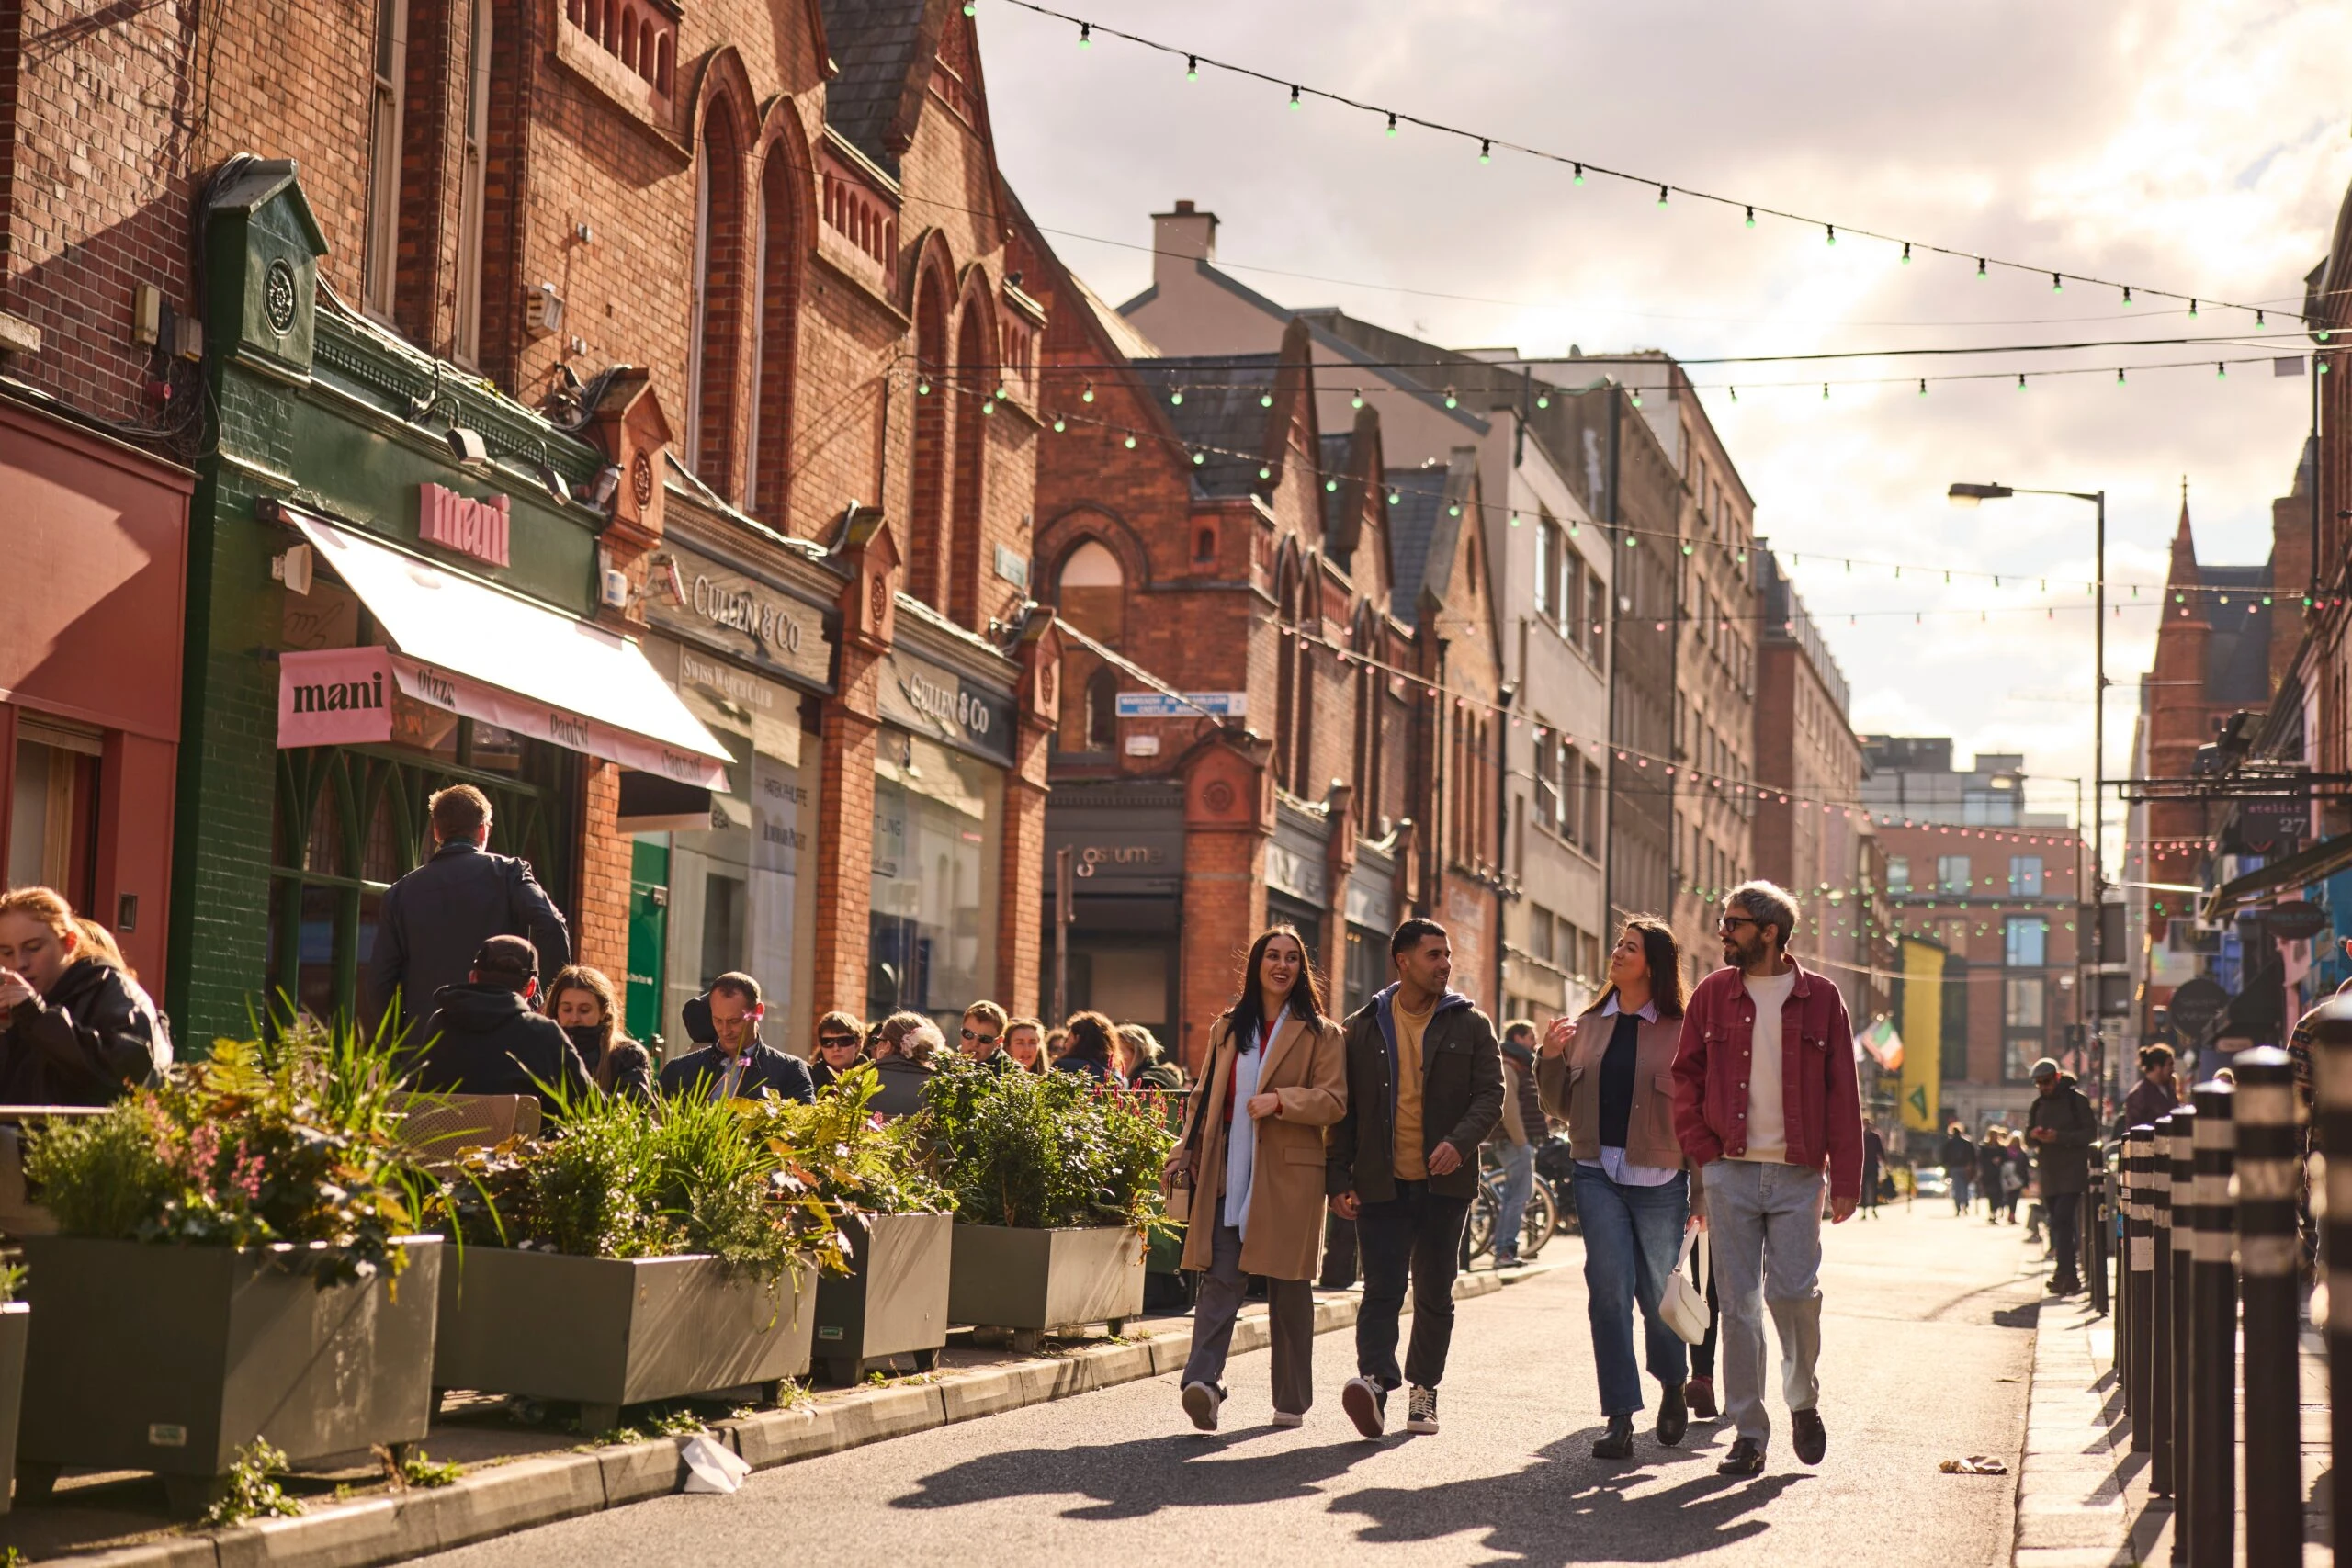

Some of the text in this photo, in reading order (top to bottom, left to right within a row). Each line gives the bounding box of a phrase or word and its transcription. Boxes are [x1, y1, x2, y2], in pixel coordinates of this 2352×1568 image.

[426, 482, 511, 568] mani
[692, 574, 759, 636] CULLEN
[760, 603, 773, 645] &
[775, 611, 802, 654] CO
[684, 655, 713, 686] SWISS
[292, 671, 383, 714] mani
[958, 692, 970, 726] &
[970, 697, 989, 734] CO
[2278, 816, 2307, 837] 27
